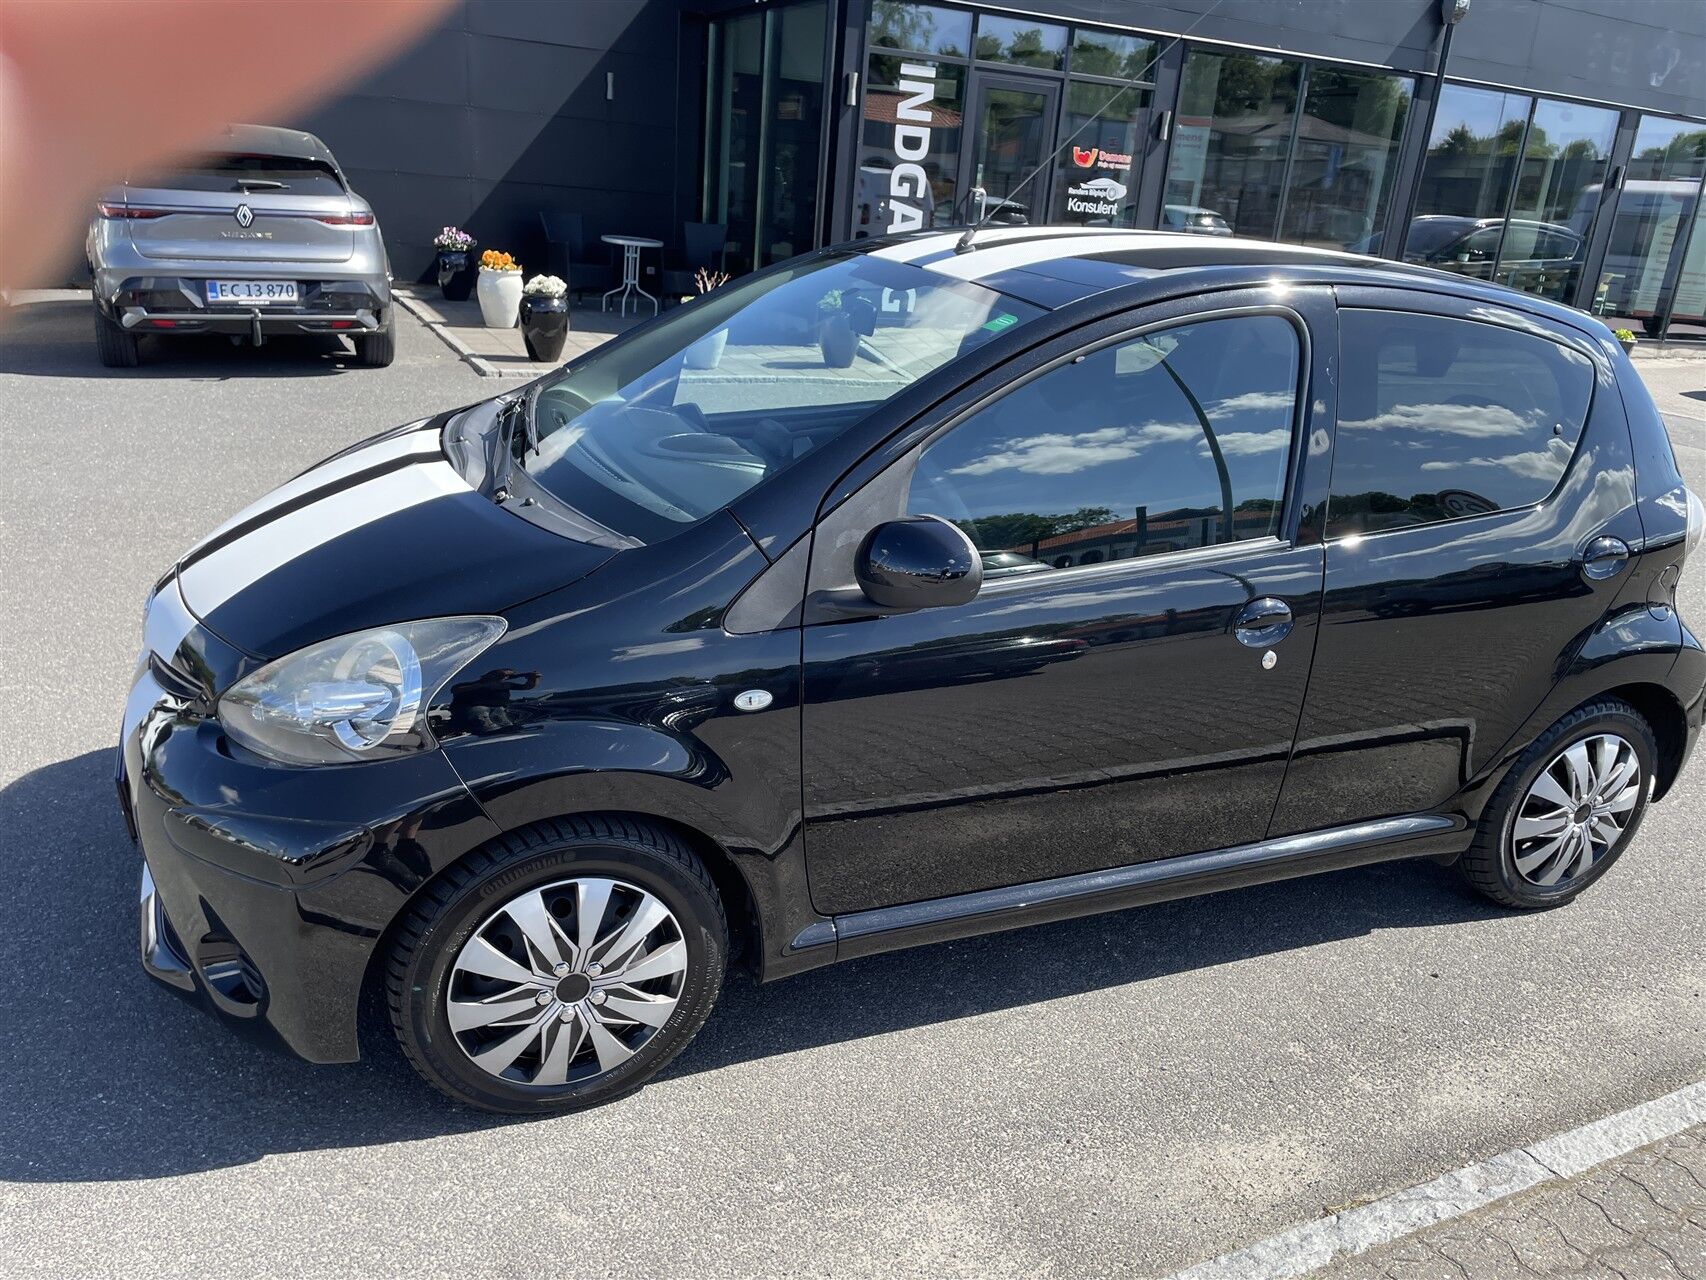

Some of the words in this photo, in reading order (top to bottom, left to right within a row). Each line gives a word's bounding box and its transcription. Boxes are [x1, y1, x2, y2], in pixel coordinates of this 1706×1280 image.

[1067, 198, 1118, 215] Konsulent
[219, 283, 240, 297] EC
[245, 283, 263, 297] 13
[266, 283, 295, 298] 870
